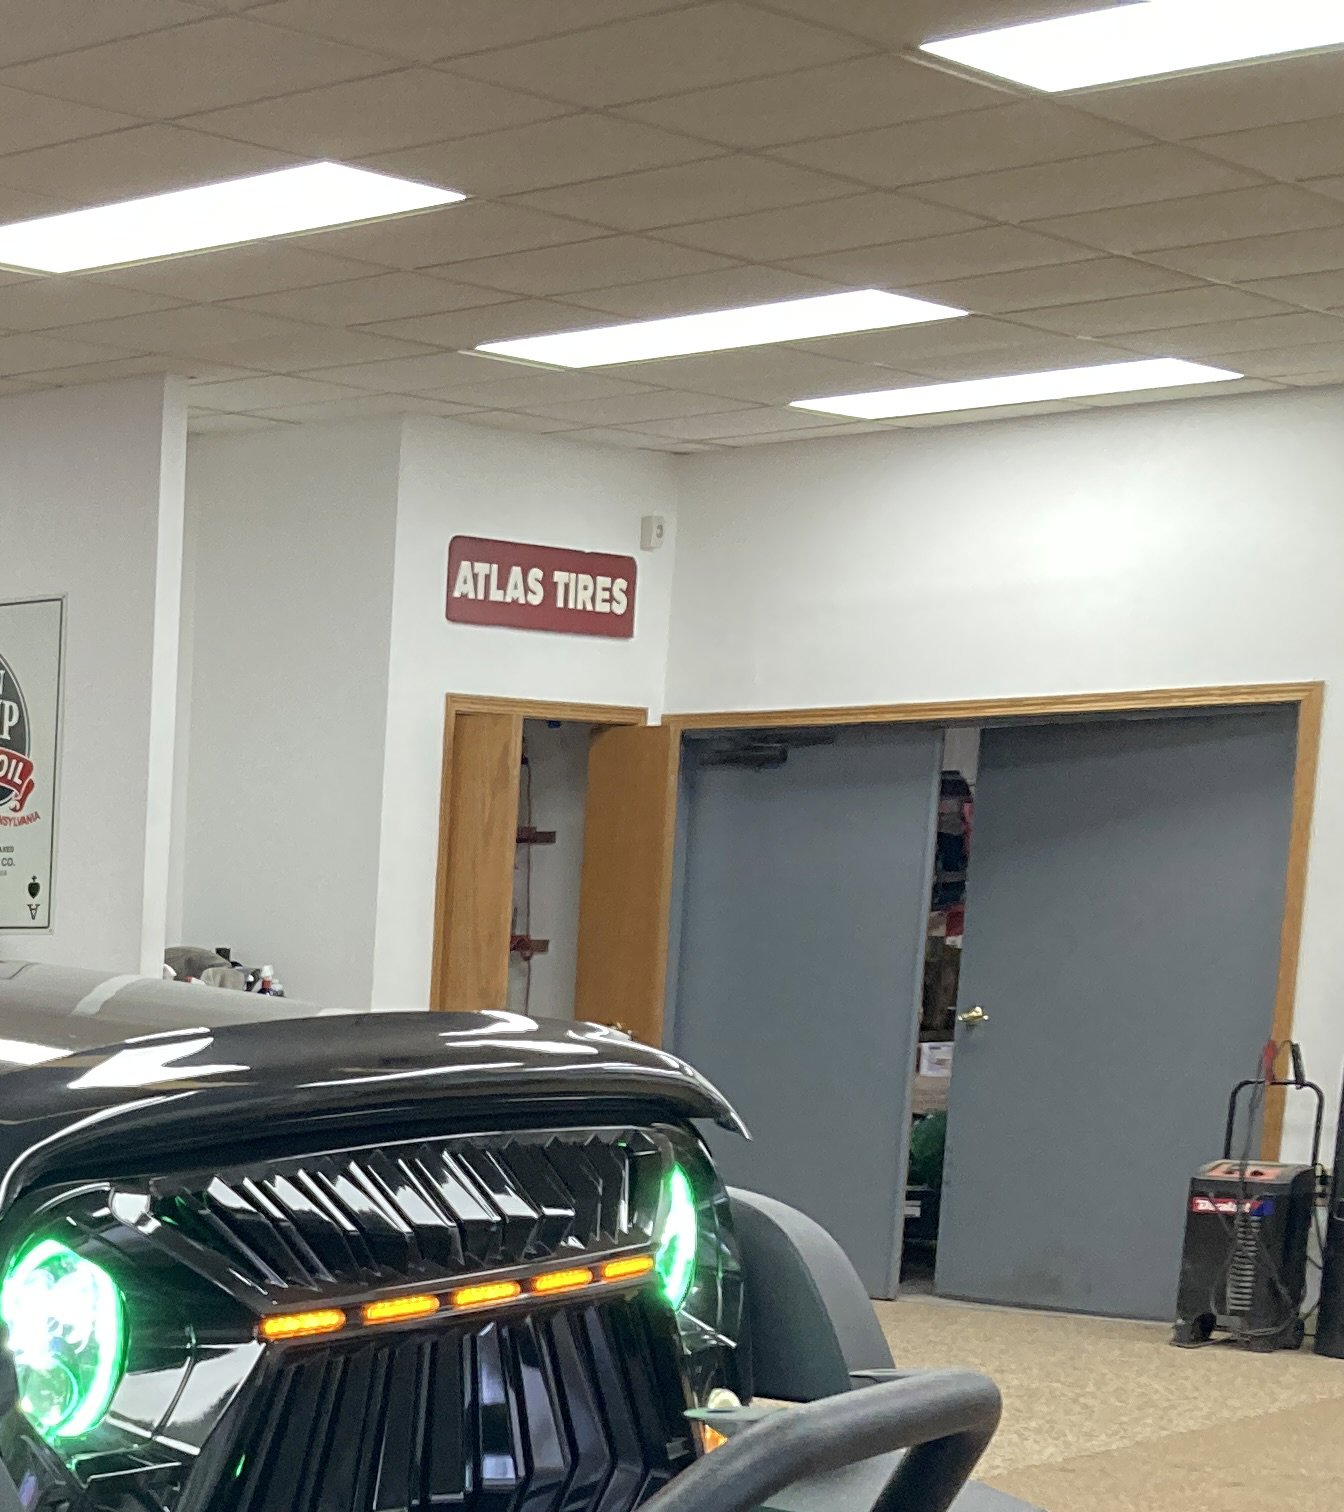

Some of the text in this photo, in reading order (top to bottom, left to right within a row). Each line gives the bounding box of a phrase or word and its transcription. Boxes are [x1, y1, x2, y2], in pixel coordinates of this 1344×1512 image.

[452, 560, 628, 616] ATLAS TIRES
[1, 857, 16, 867] CO.
